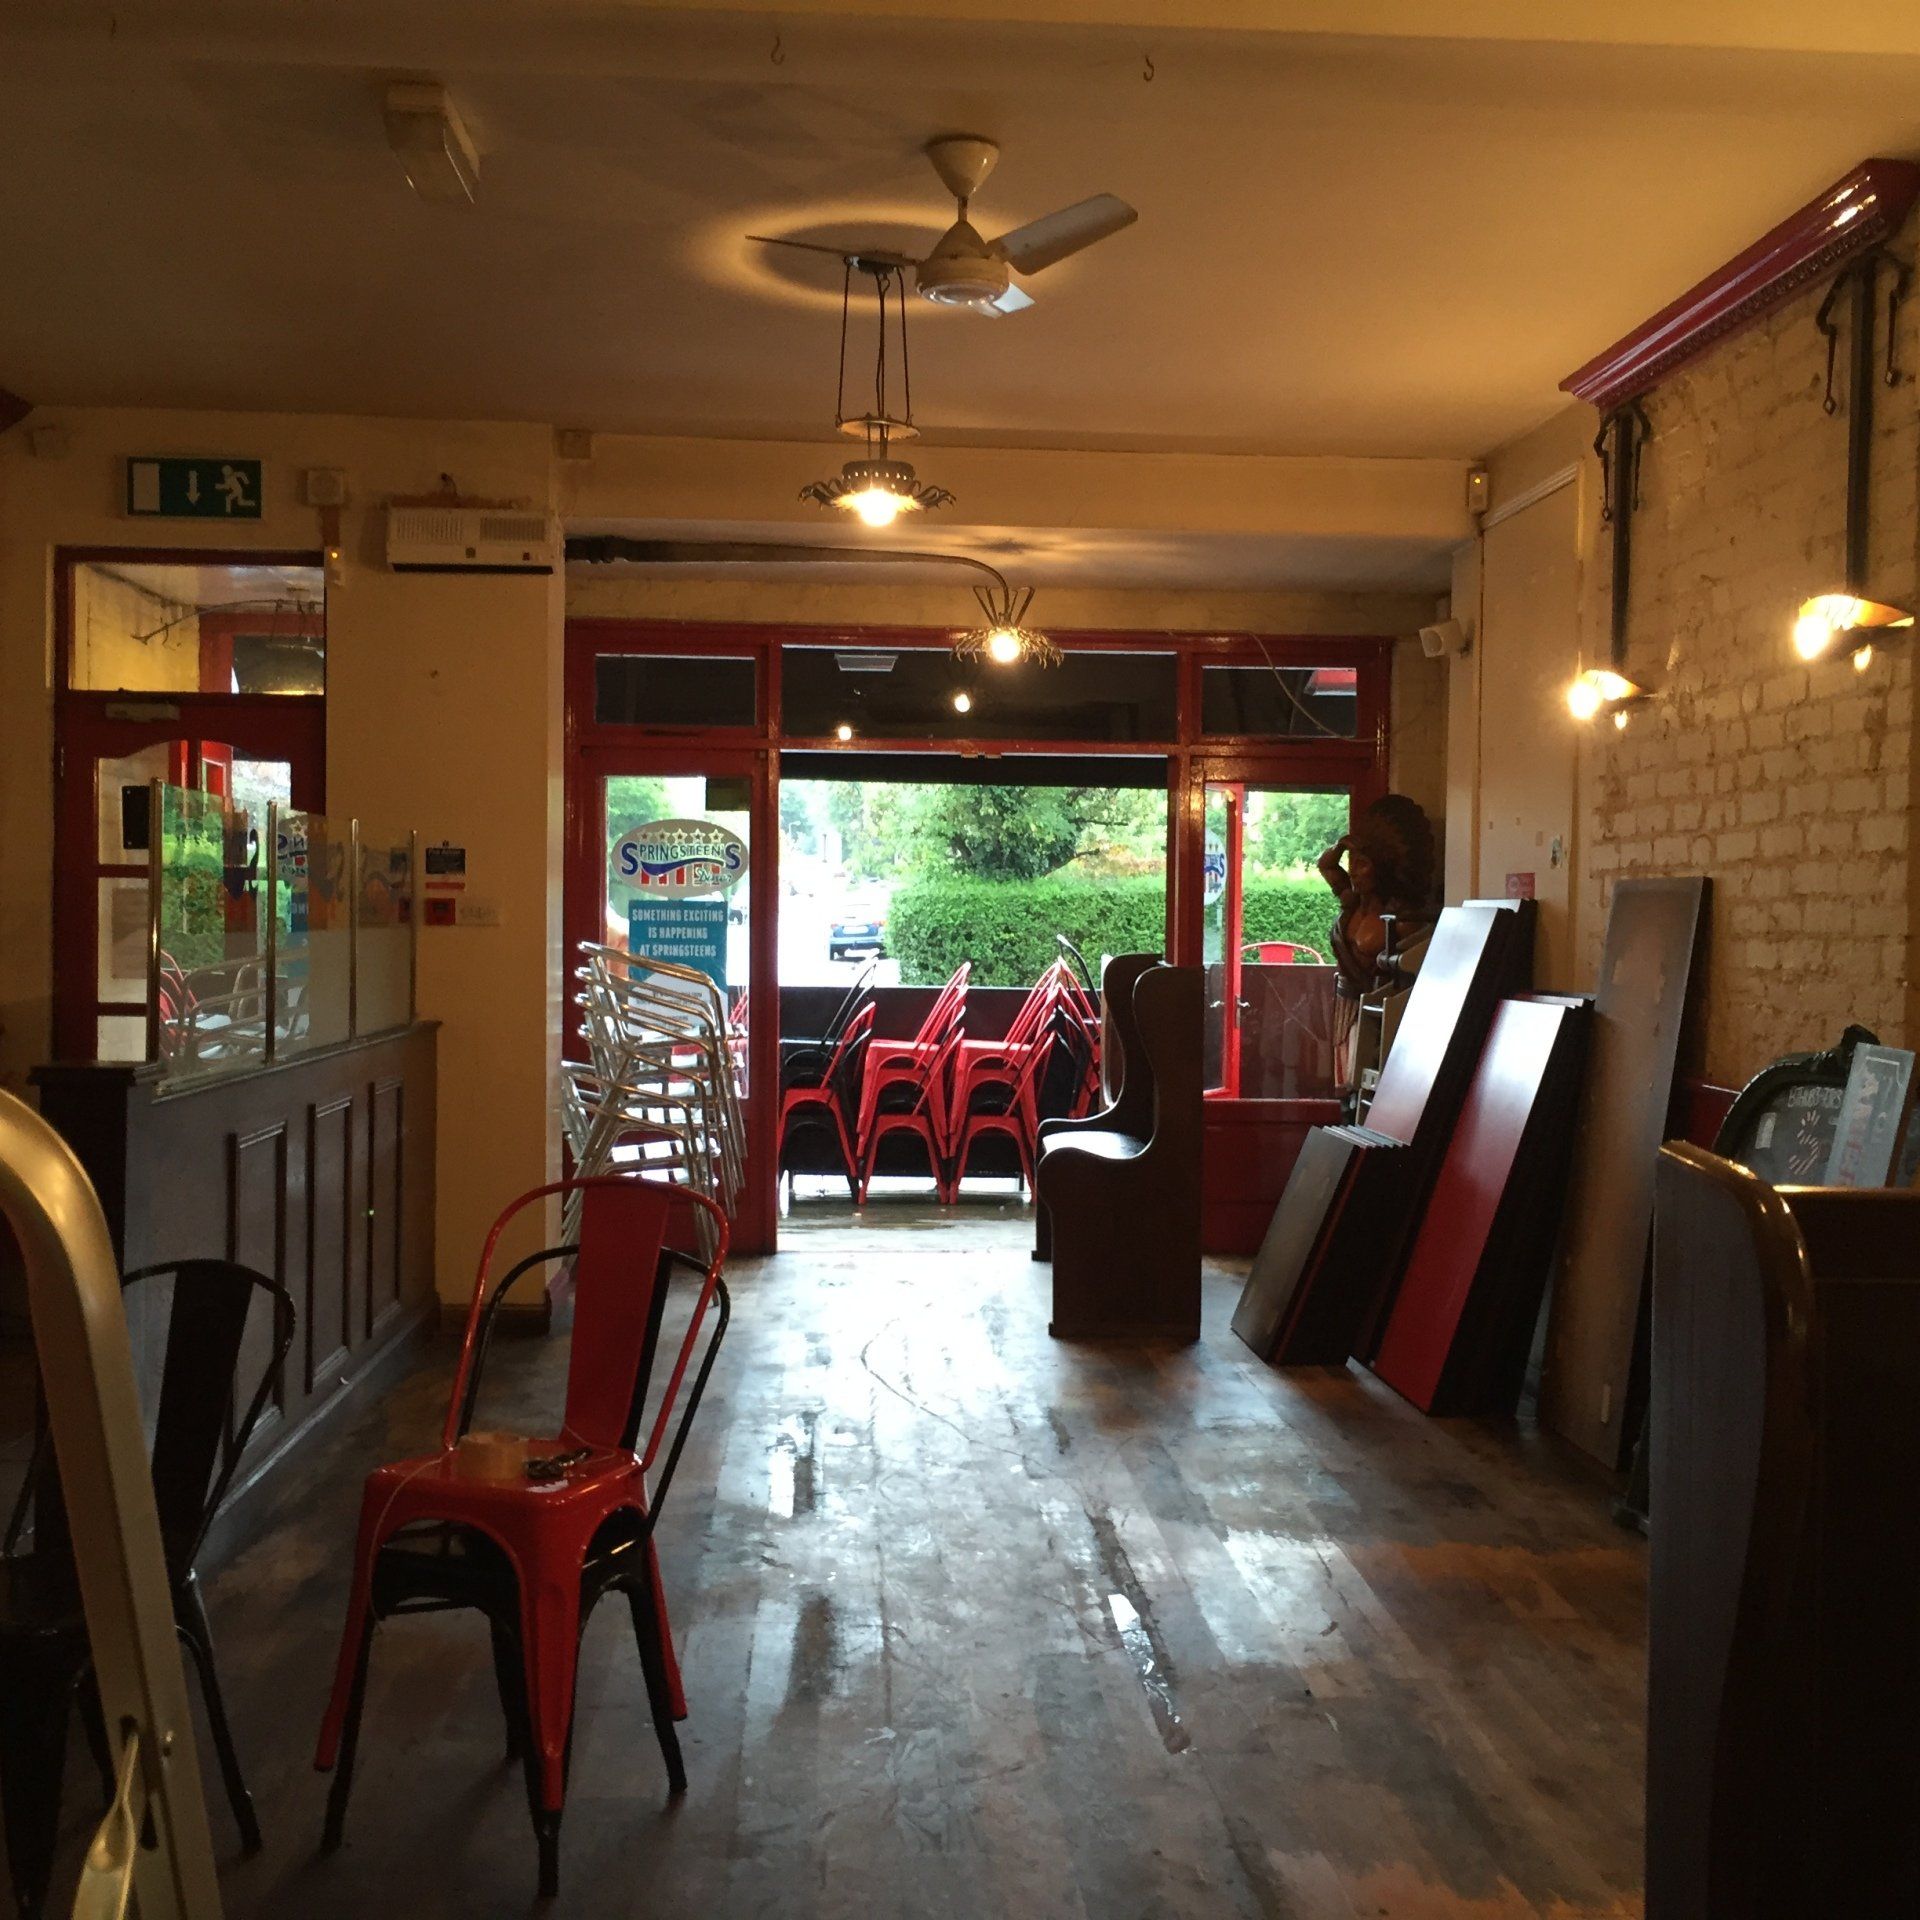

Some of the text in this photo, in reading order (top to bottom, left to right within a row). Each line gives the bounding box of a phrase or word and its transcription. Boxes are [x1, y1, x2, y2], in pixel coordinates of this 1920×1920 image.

[632, 909, 724, 922] SOMETHING EXCITING
[648, 927, 708, 940] IS HAPPENING
[639, 944, 717, 958] AT SPRINGSTEENS
